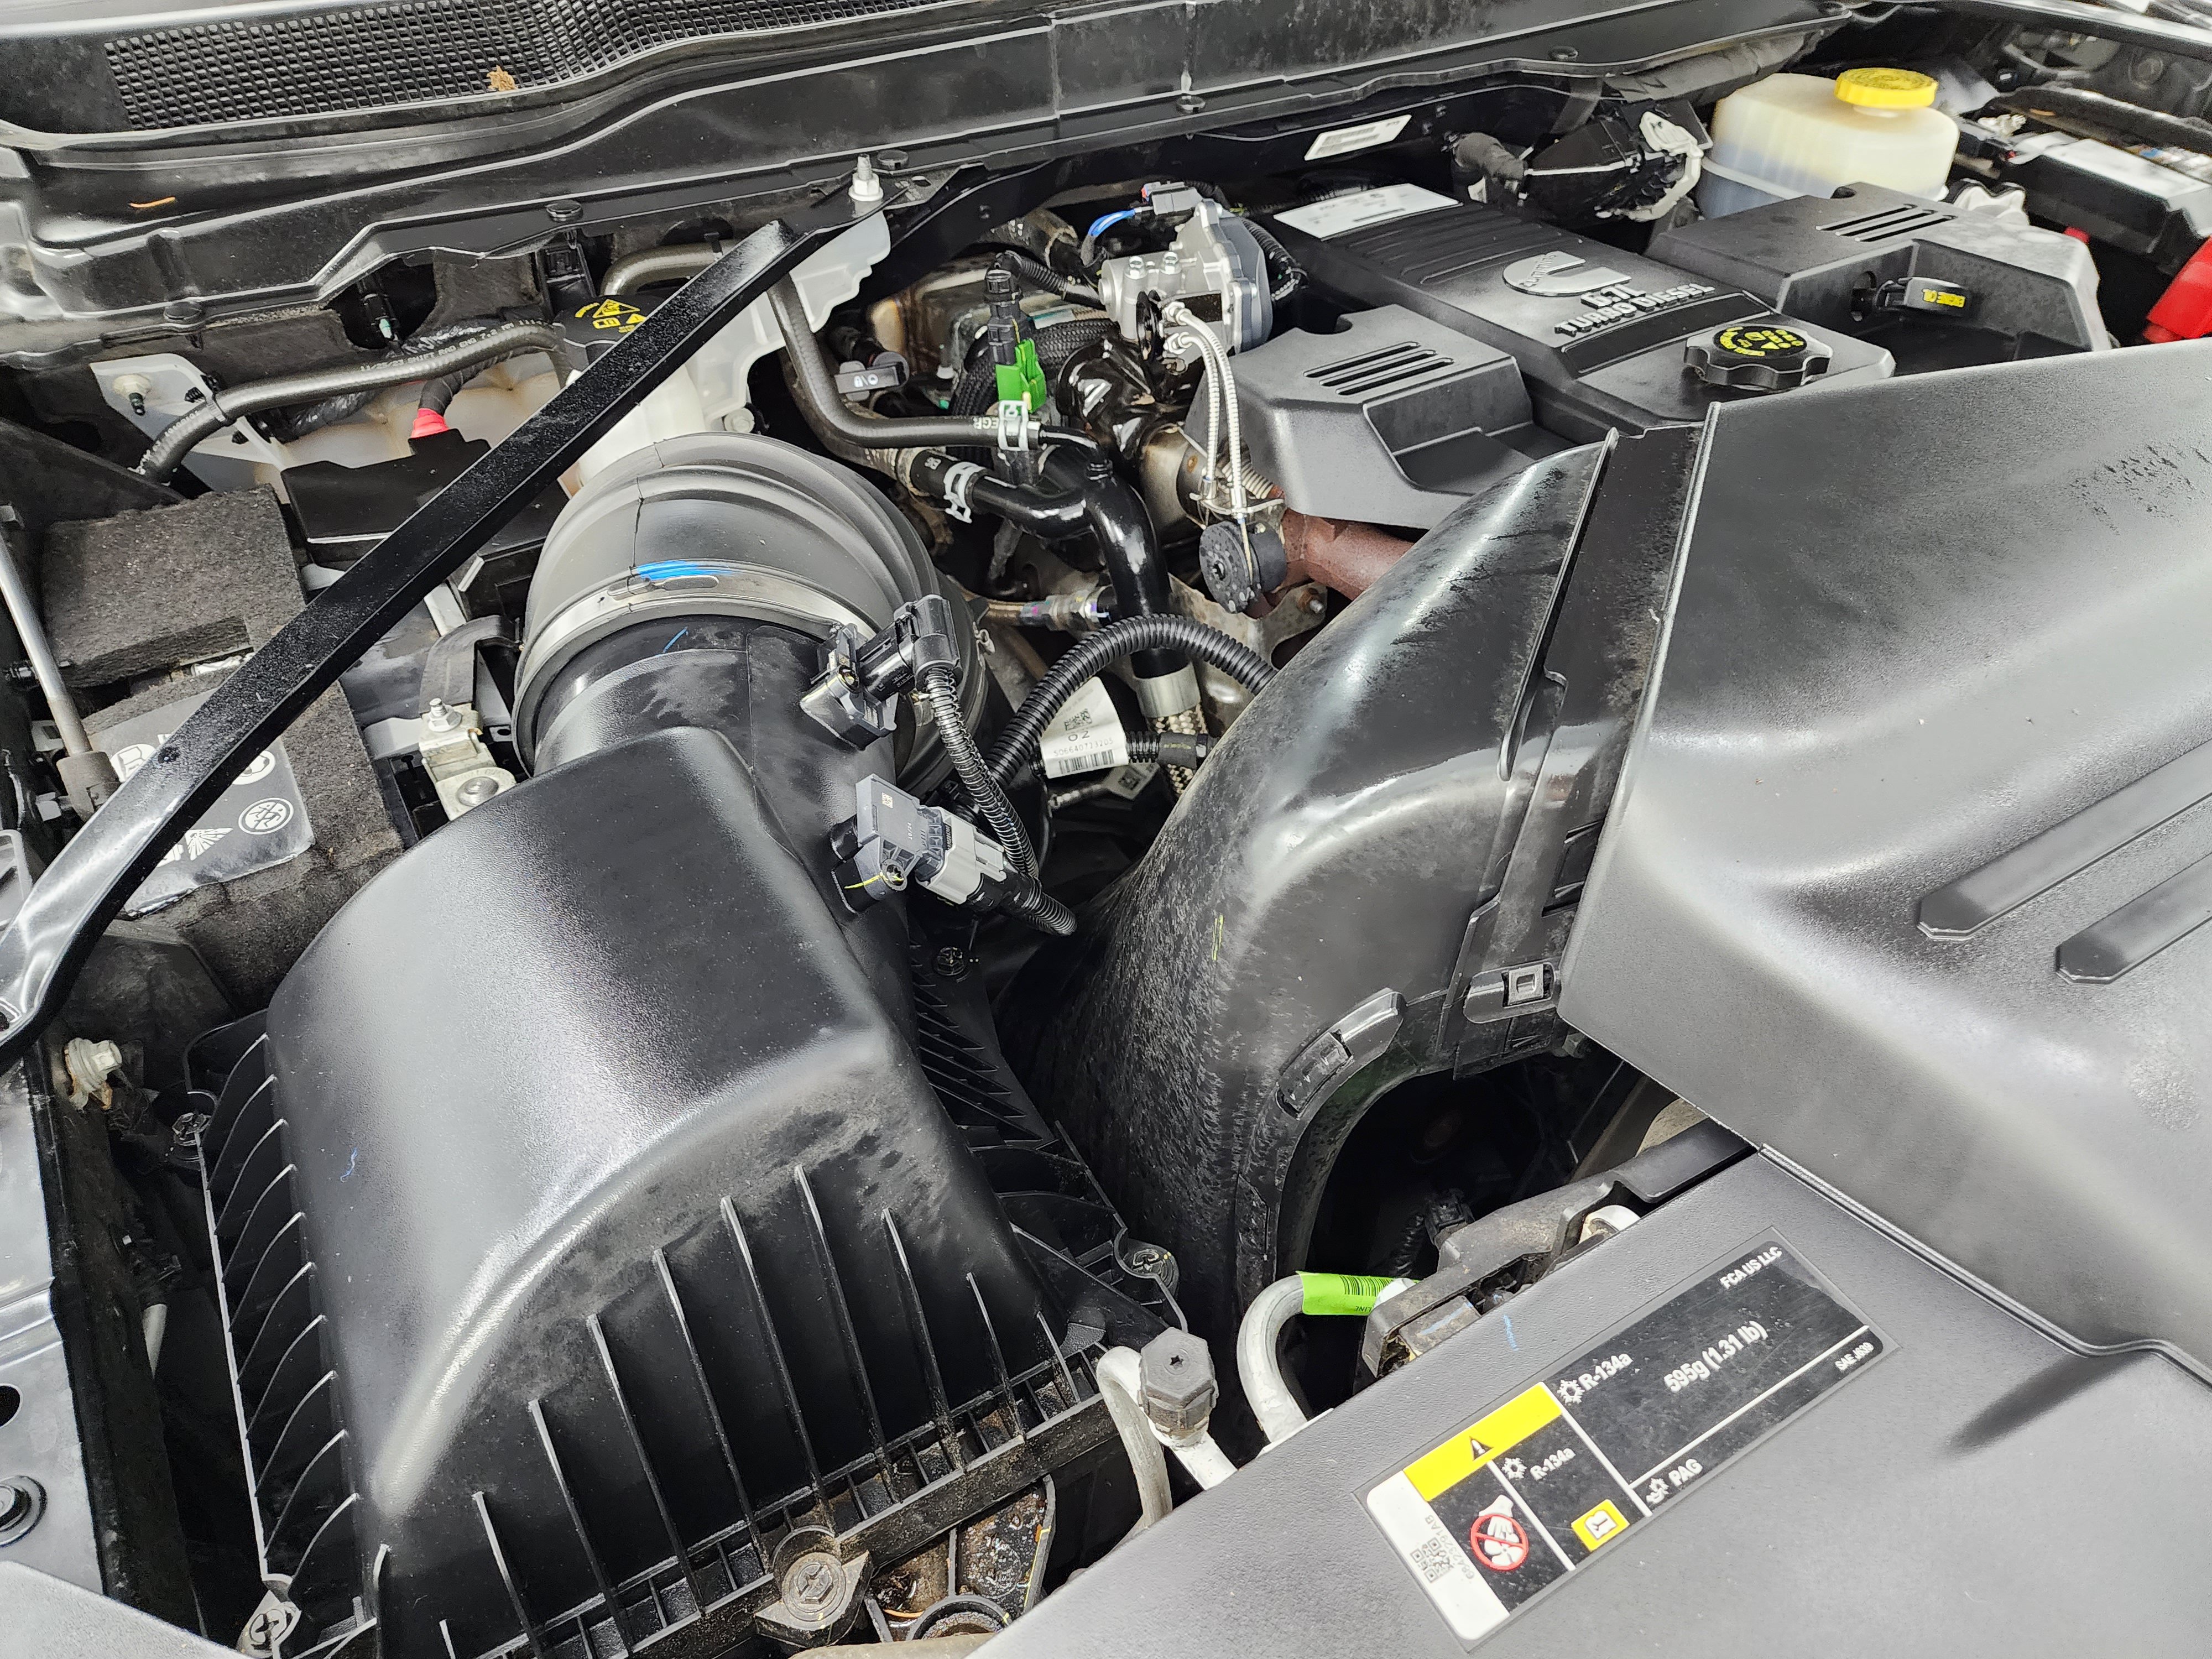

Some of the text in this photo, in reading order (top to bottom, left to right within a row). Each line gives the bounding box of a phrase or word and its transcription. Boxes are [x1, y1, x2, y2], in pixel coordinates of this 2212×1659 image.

[1554, 283, 1715, 337] TURBO DIESEL
[1580, 284, 1646, 309] 6.7L
[1720, 1246, 1782, 1290] FCA US LLC
[1578, 1354, 1633, 1391] R-134a
[1664, 1321, 1768, 1392] 595g (1.31 lb)
[1835, 1353, 1857, 1370] SAE
[1530, 1448, 1576, 1480] R-134a
[1668, 1458, 1703, 1486] PAG
